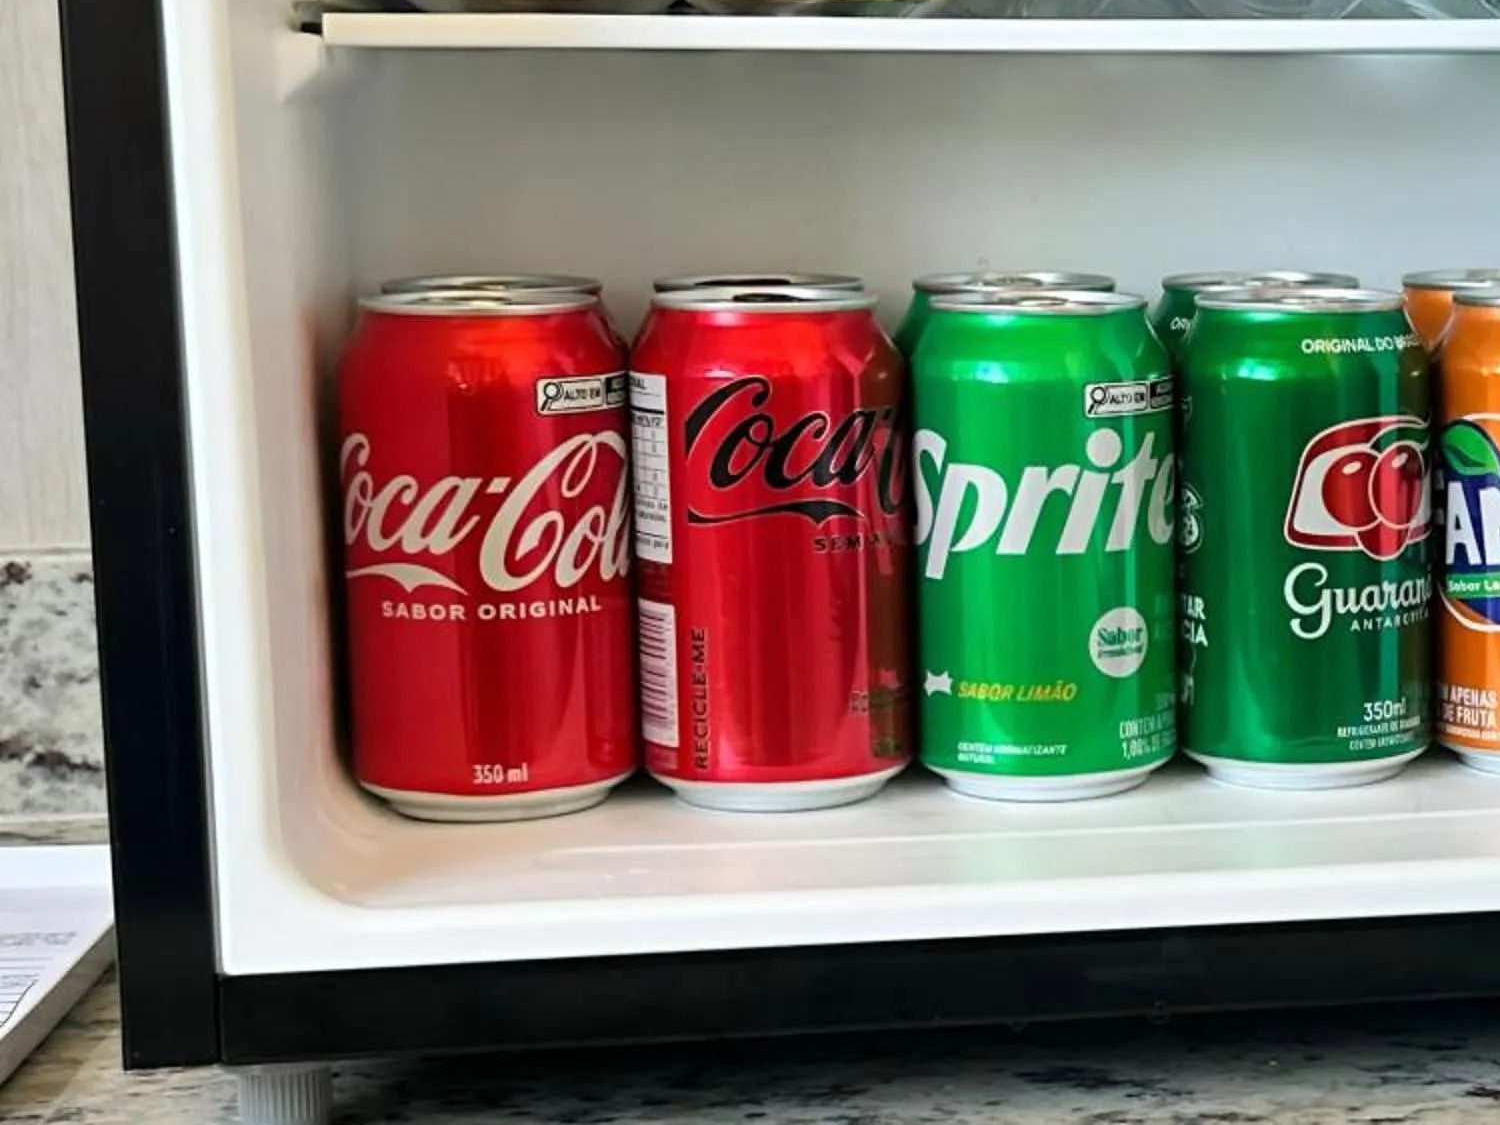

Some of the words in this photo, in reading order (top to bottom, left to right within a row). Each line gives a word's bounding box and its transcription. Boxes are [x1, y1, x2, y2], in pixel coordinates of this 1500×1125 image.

[1300, 337, 1375, 354] ORIGINAL
[813, 534, 864, 555] SEM
[1448, 578, 1482, 593] Sabor
[381, 599, 466, 620] SABOR
[477, 594, 603, 620] ORIGINAL
[1097, 625, 1143, 646] Sabor
[690, 626, 711, 772] RECICLE-ME
[956, 681, 1013, 701] SABOR
[1015, 679, 1079, 703] LIMÃO
[1450, 684, 1498, 710] APENAS
[1456, 705, 1497, 729] FRUTA
[472, 763, 505, 785] 350
[507, 762, 529, 783] ml
